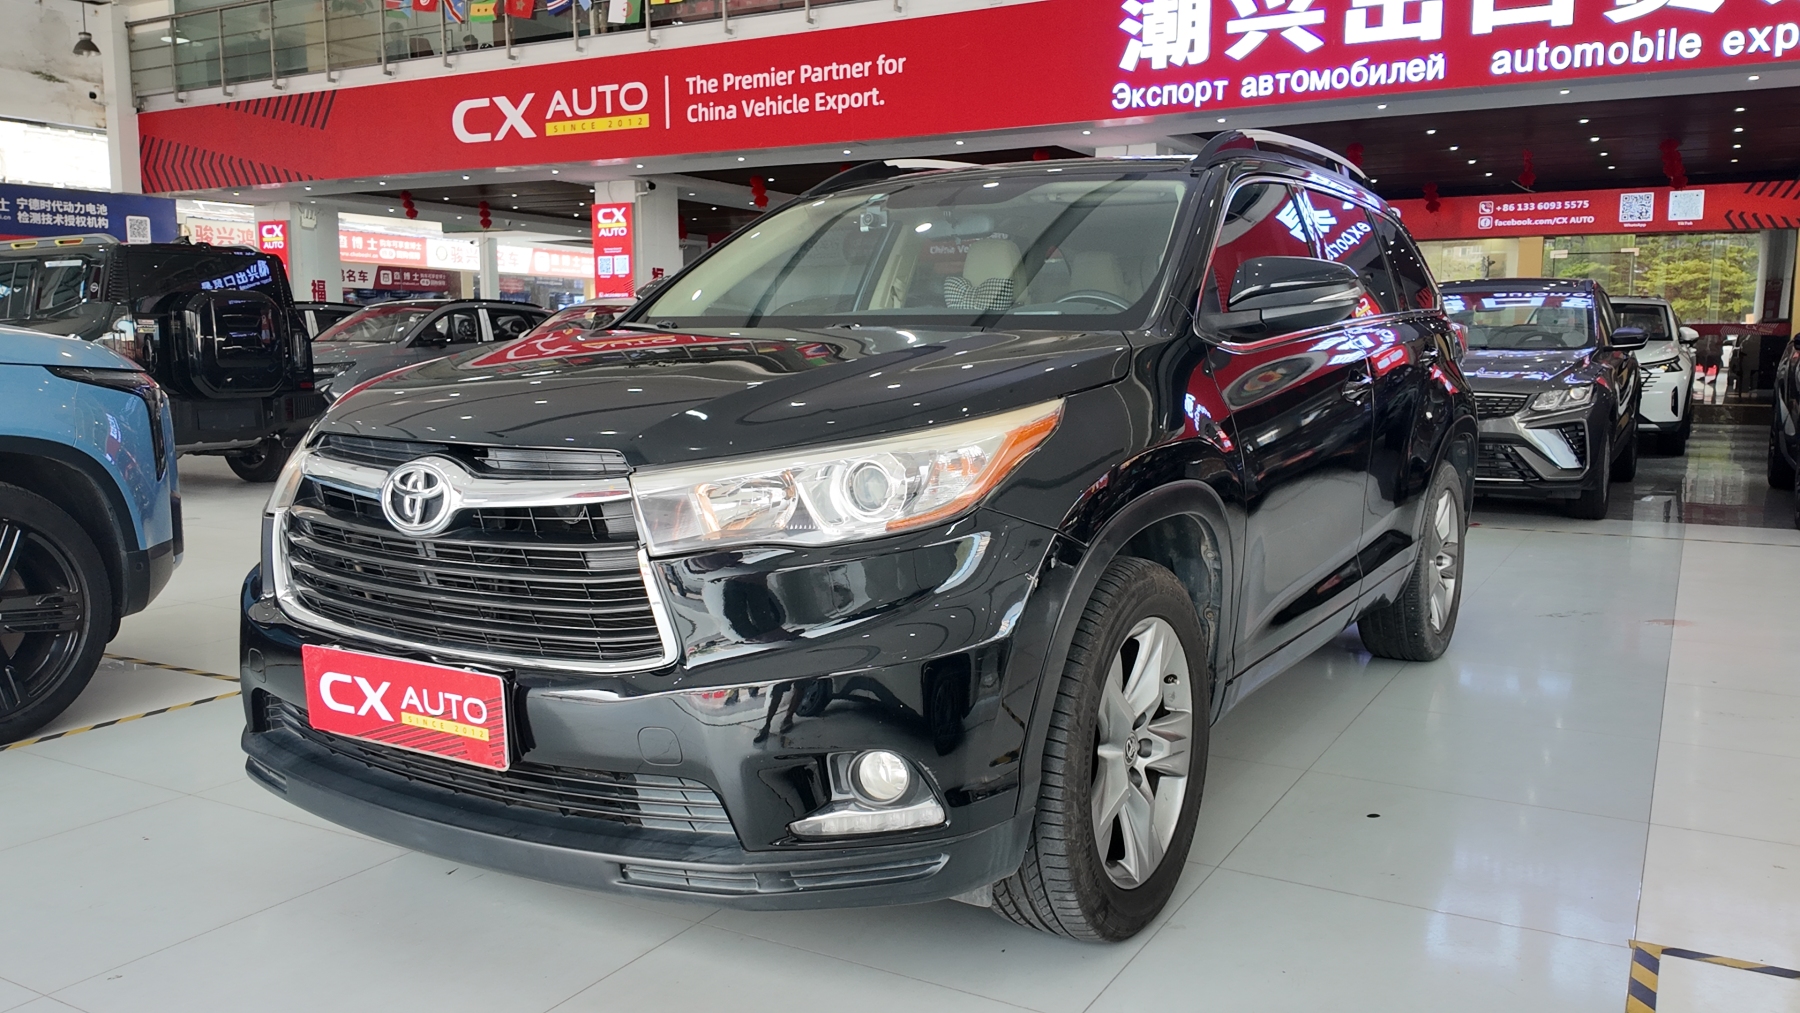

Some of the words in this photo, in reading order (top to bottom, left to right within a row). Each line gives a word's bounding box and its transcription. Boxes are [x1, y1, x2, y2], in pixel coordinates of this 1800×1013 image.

[1118, 0, 1780, 72] 潮兴出
[1490, 28, 1702, 75] automobile
[686, 75, 718, 95] The
[723, 67, 795, 91] Premier
[800, 60, 872, 84] Partner
[876, 54, 906, 75] for
[1112, 79, 1229, 110] Экспорт
[1240, 53, 1445, 99] автомобилей
[452, 93, 537, 143] CX
[545, 82, 648, 119] AUTO
[687, 102, 737, 123] China
[742, 93, 809, 118] Vehicle
[815, 87, 885, 114] Export.
[554, 122, 596, 133] SINCE
[608, 118, 643, 128] 2012
[16, 197, 108, 216] 宁德时代动力电池
[597, 207, 626, 223] CX
[1496, 203, 1515, 212] +86
[1517, 202, 1535, 211] 133
[1537, 201, 1562, 210] 6093
[1564, 200, 1589, 209] 5575
[17, 211, 109, 229] 检测技术授权机构
[1494, 217, 1568, 226] facebook.com/CX
[1570, 216, 1594, 224] AUTO
[262, 225, 283, 237] CX
[599, 227, 627, 237] AUTO
[263, 241, 284, 249] AUTO
[311, 280, 326, 302] 福
[319, 671, 394, 722] CX
[401, 686, 487, 724] AUTO
[408, 715, 444, 730] SINCE
[454, 725, 484, 738] 2012
